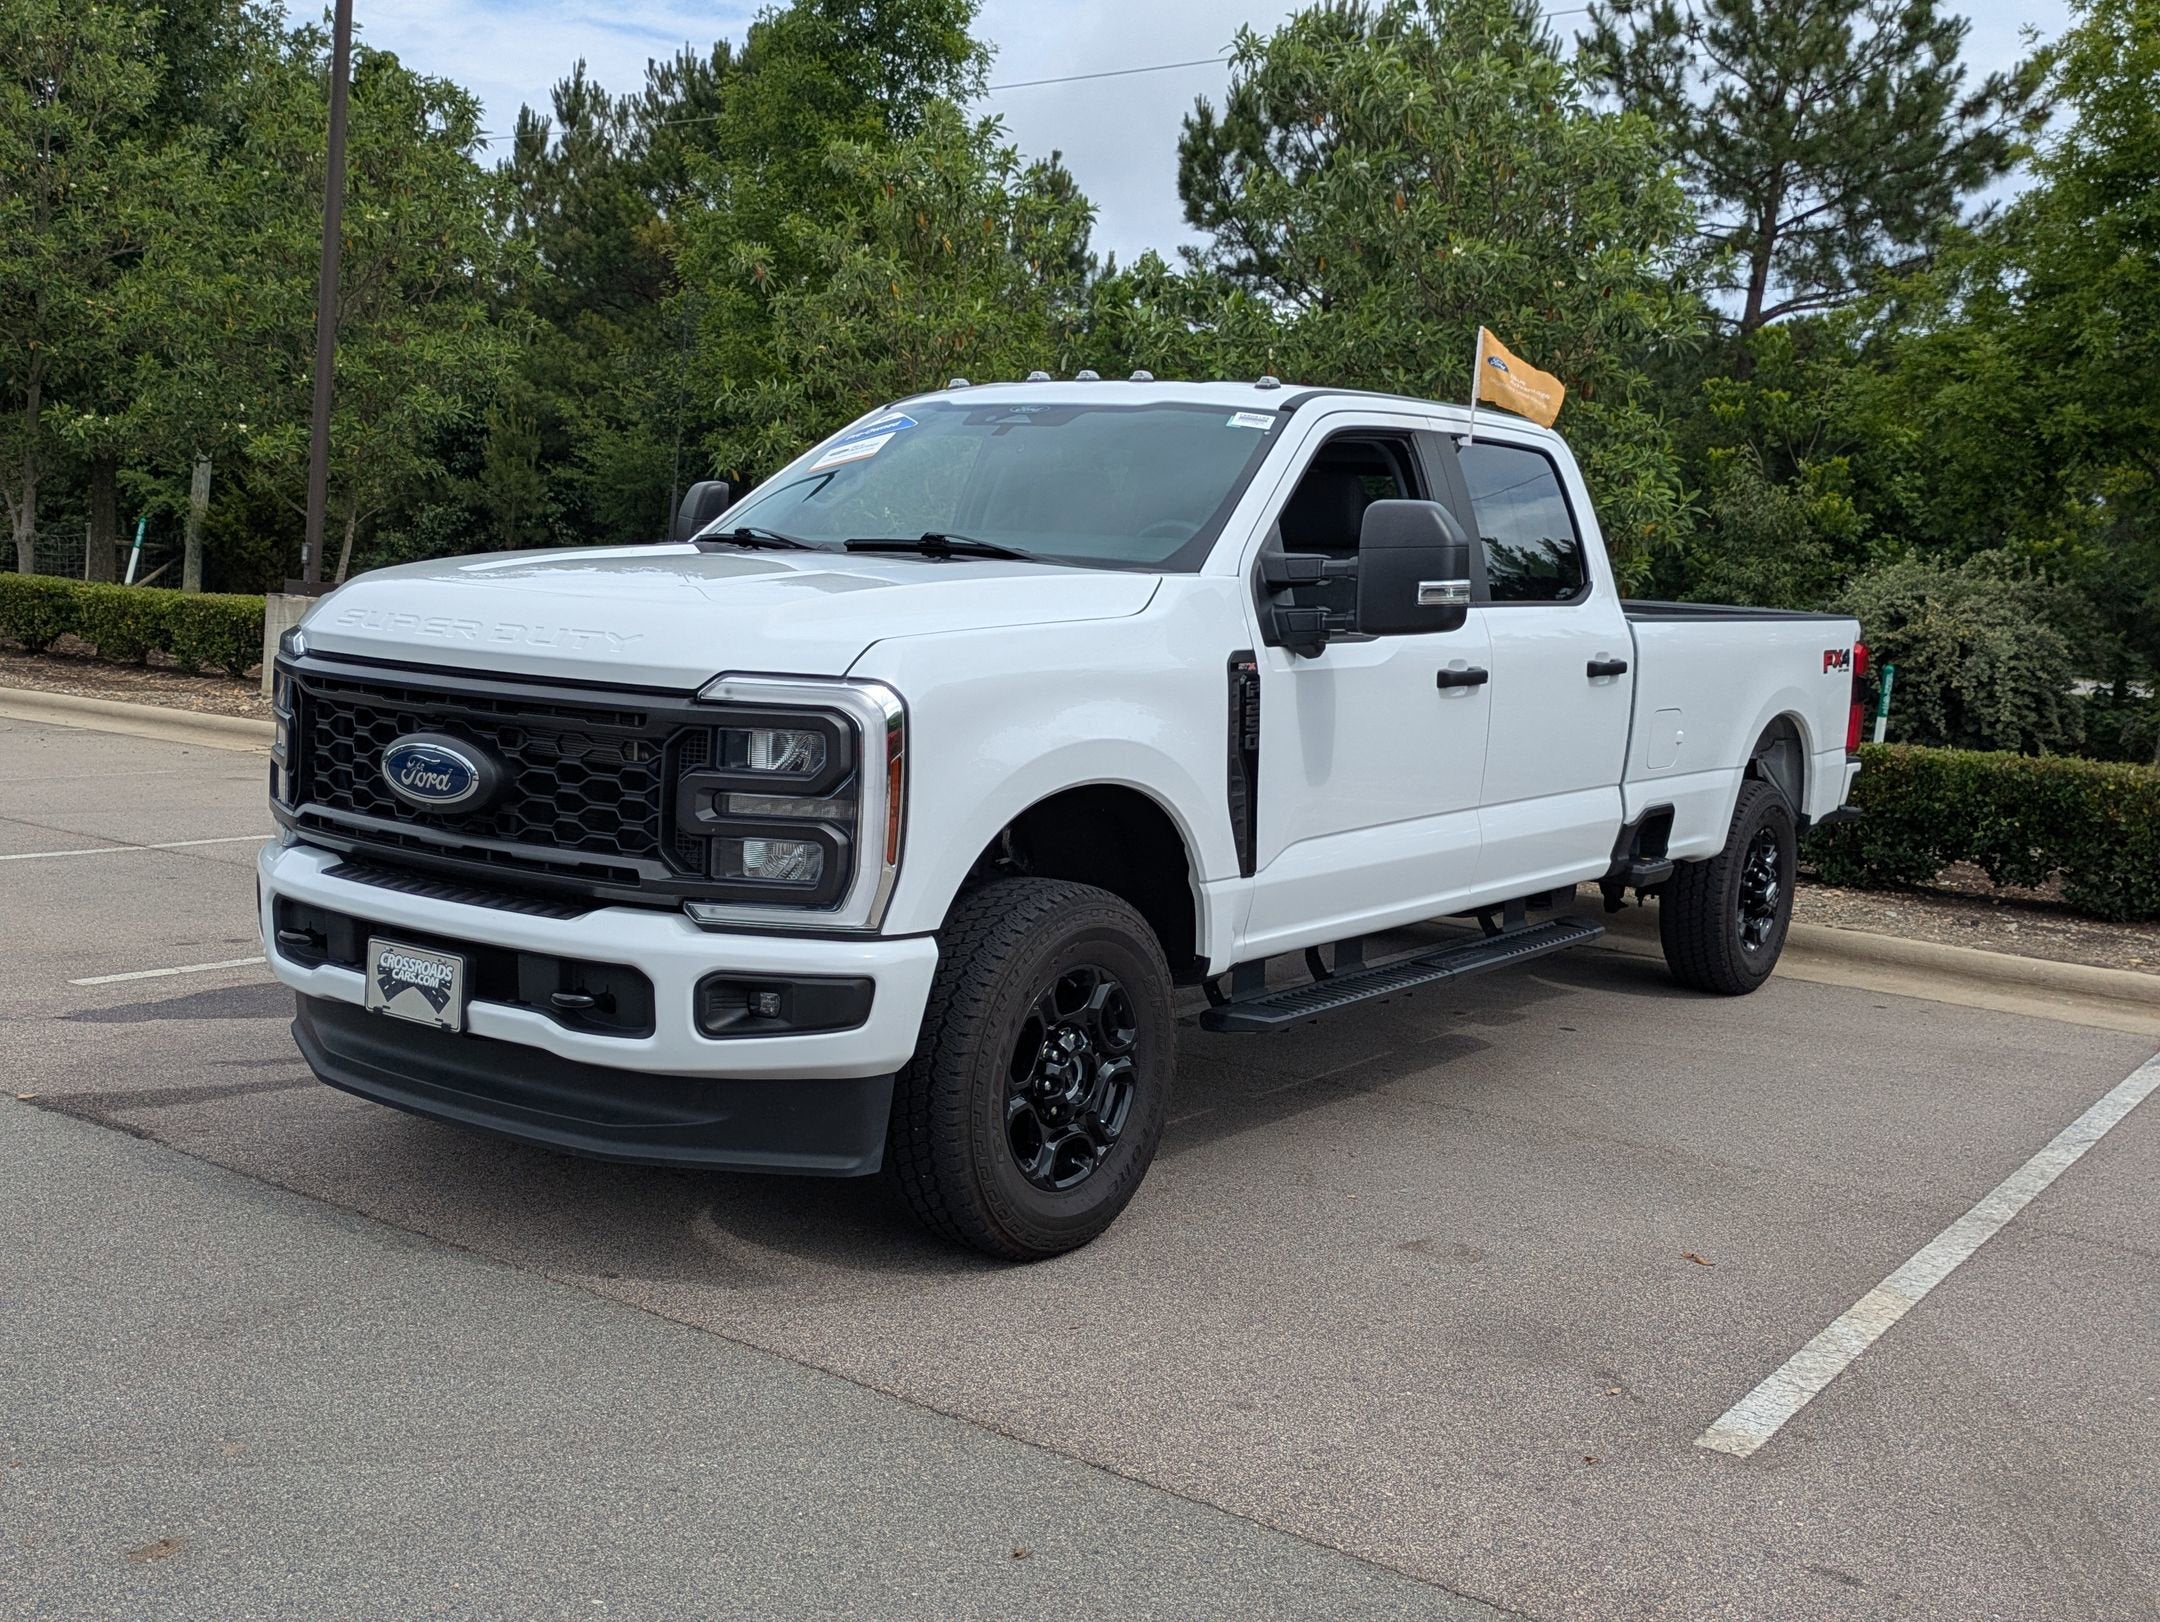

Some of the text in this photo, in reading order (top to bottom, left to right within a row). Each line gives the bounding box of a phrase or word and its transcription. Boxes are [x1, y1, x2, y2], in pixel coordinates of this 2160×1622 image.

[337, 608, 645, 653] SUPER DUTY
[1823, 648, 1850, 674] FX4
[400, 754, 454, 791] Ford
[379, 951, 454, 982] CROSSROADS
[391, 968, 440, 988] CARS.COM
